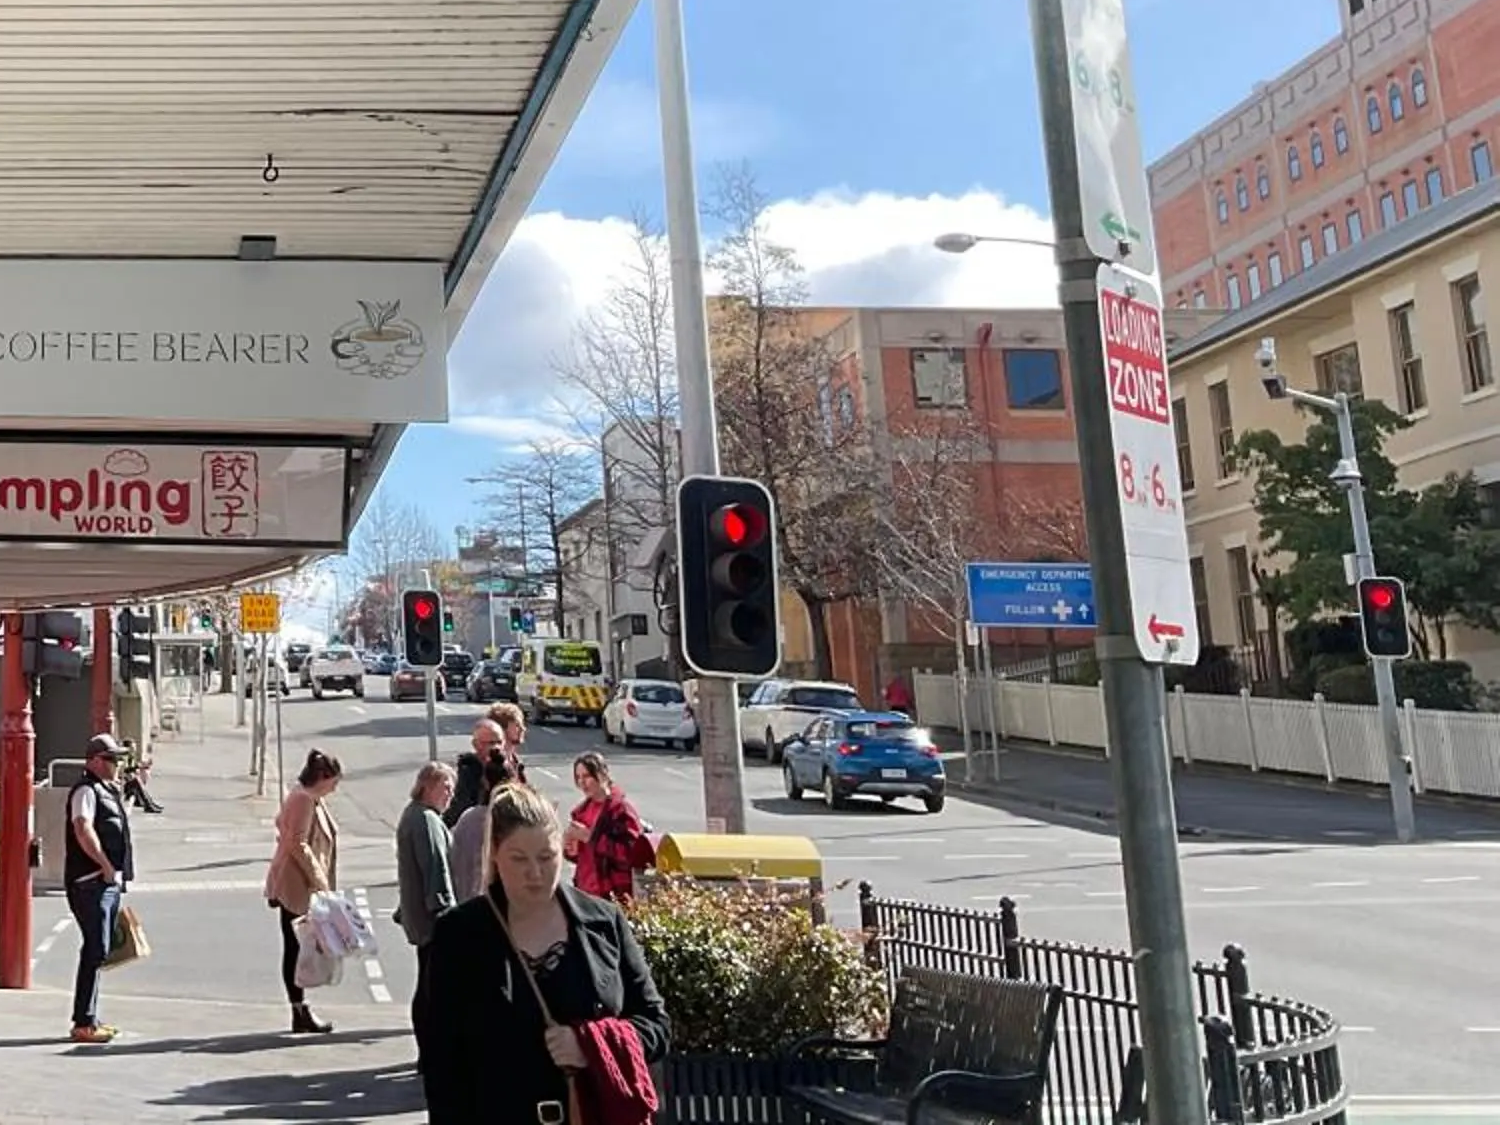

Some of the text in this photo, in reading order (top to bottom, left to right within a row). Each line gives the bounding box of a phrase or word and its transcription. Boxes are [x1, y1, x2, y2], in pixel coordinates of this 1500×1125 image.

[1102, 294, 1161, 358] LOADING
[152, 332, 311, 365] BEARER
[1109, 357, 1168, 417] ZONE
[209, 454, 250, 535] 餃子
[73, 514, 154, 535] WORLD
[979, 569, 1092, 581] EMERGENCY DEPARTME
[1025, 581, 1062, 593] ACCESS
